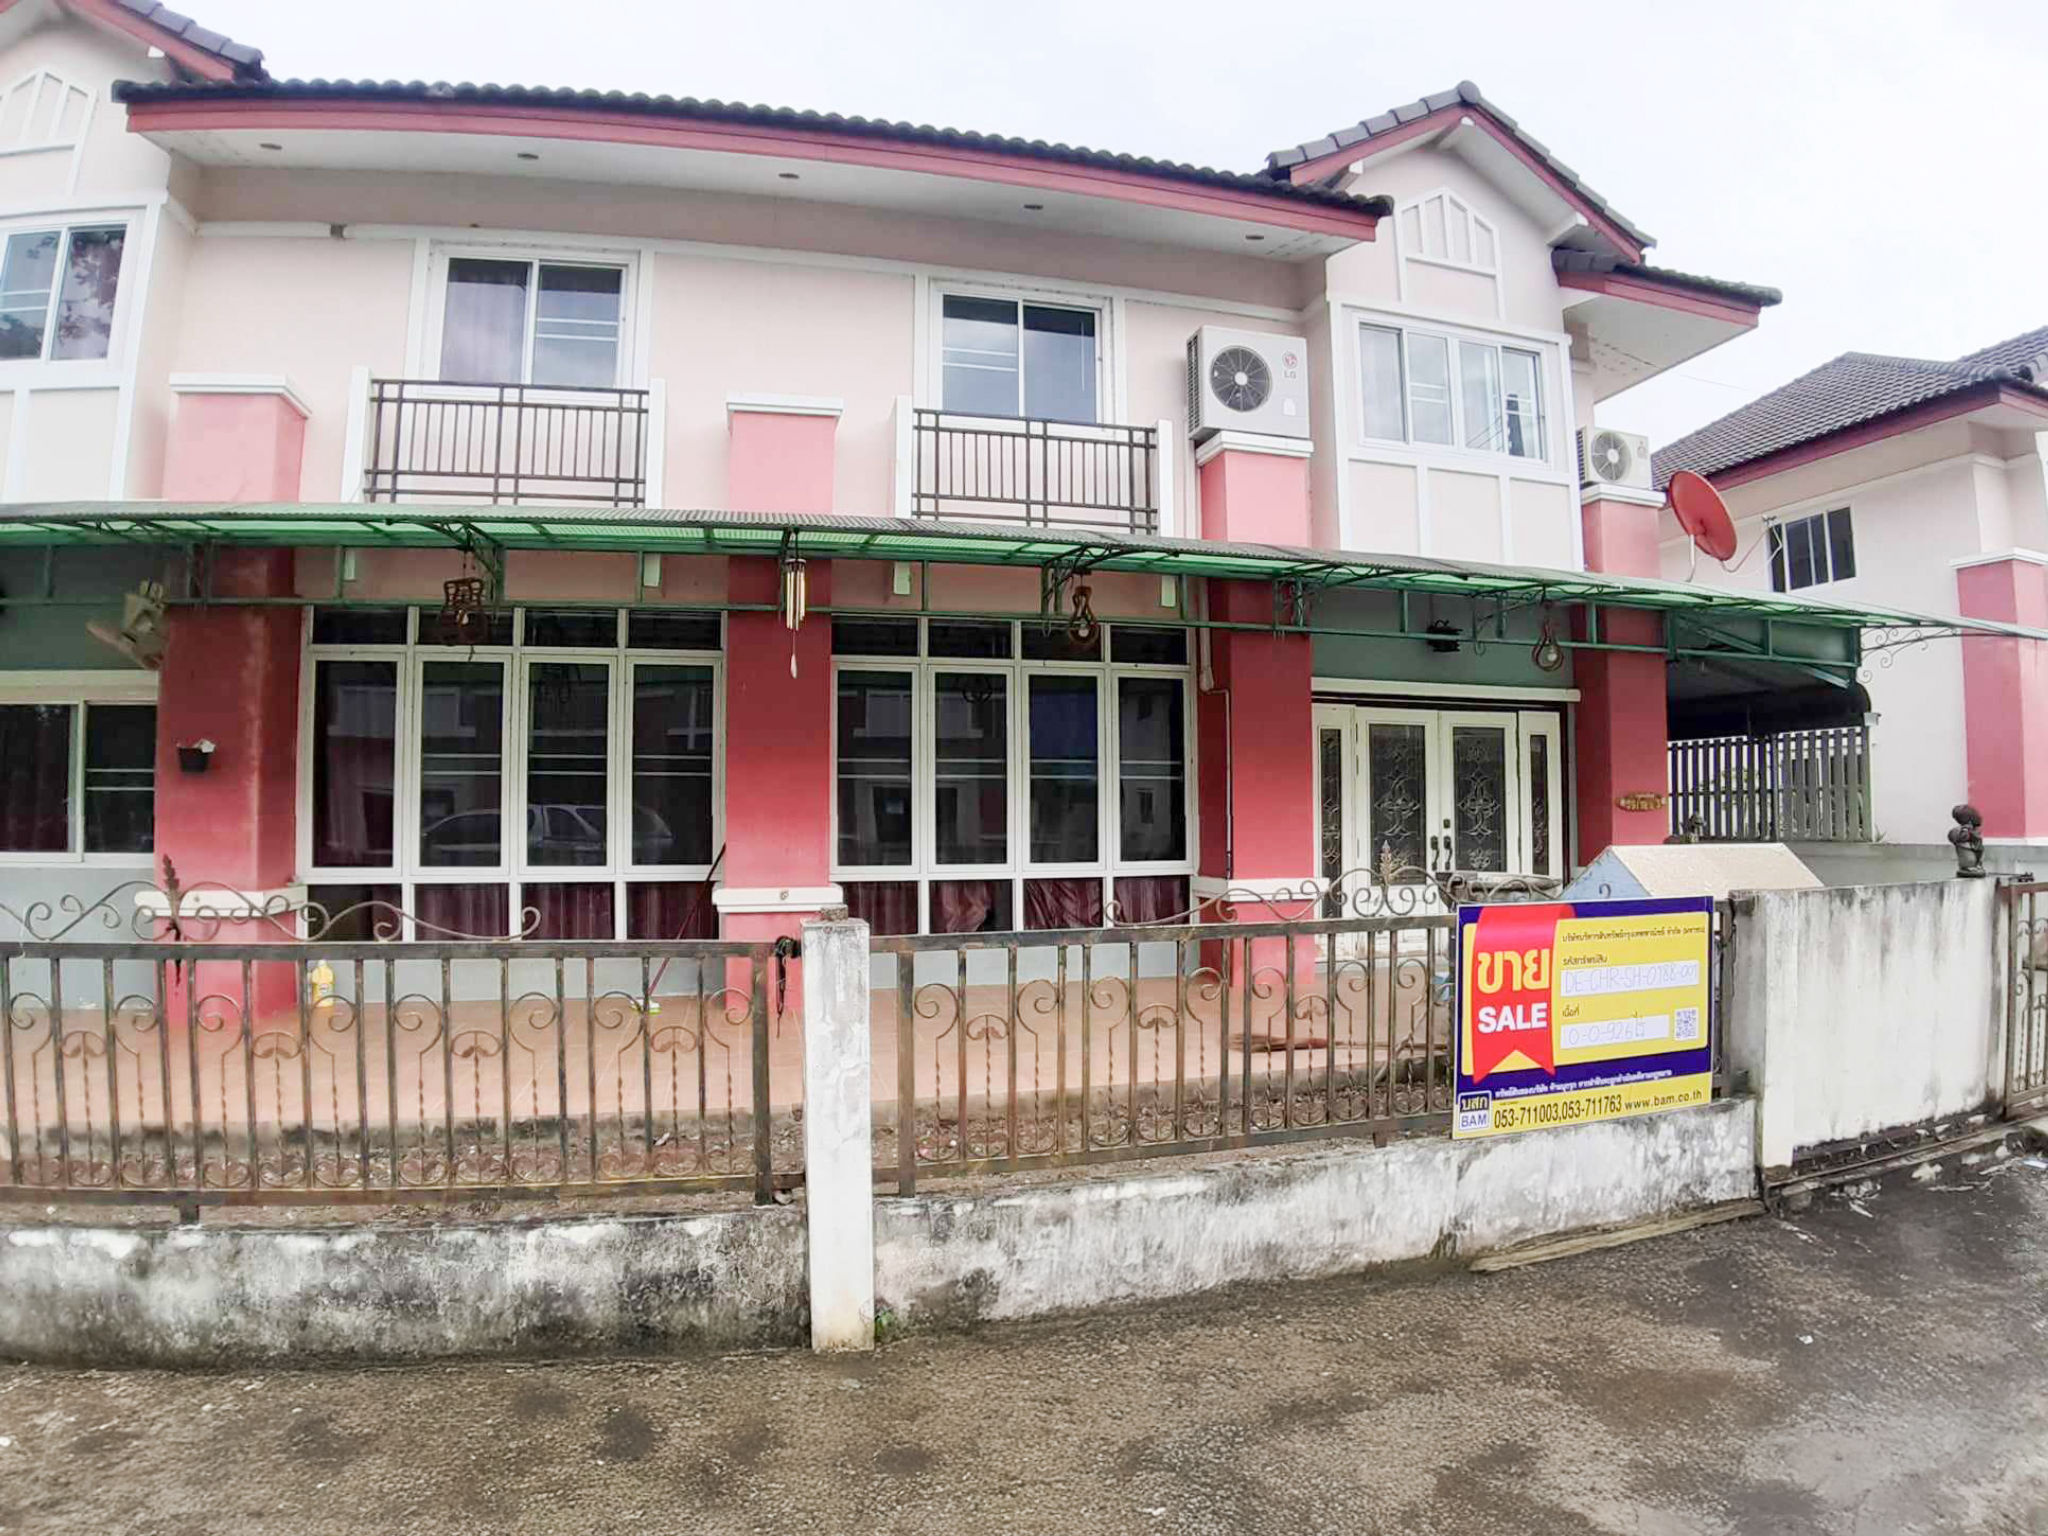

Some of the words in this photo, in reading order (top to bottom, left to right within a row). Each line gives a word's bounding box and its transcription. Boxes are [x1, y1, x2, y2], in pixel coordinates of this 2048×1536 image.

[1477, 948, 1550, 994] ขาย
[1477, 1002, 1548, 1034] SALE
[1624, 1090, 1703, 1110] www.bam.co.th
[1461, 1114, 1487, 1128] BAM
